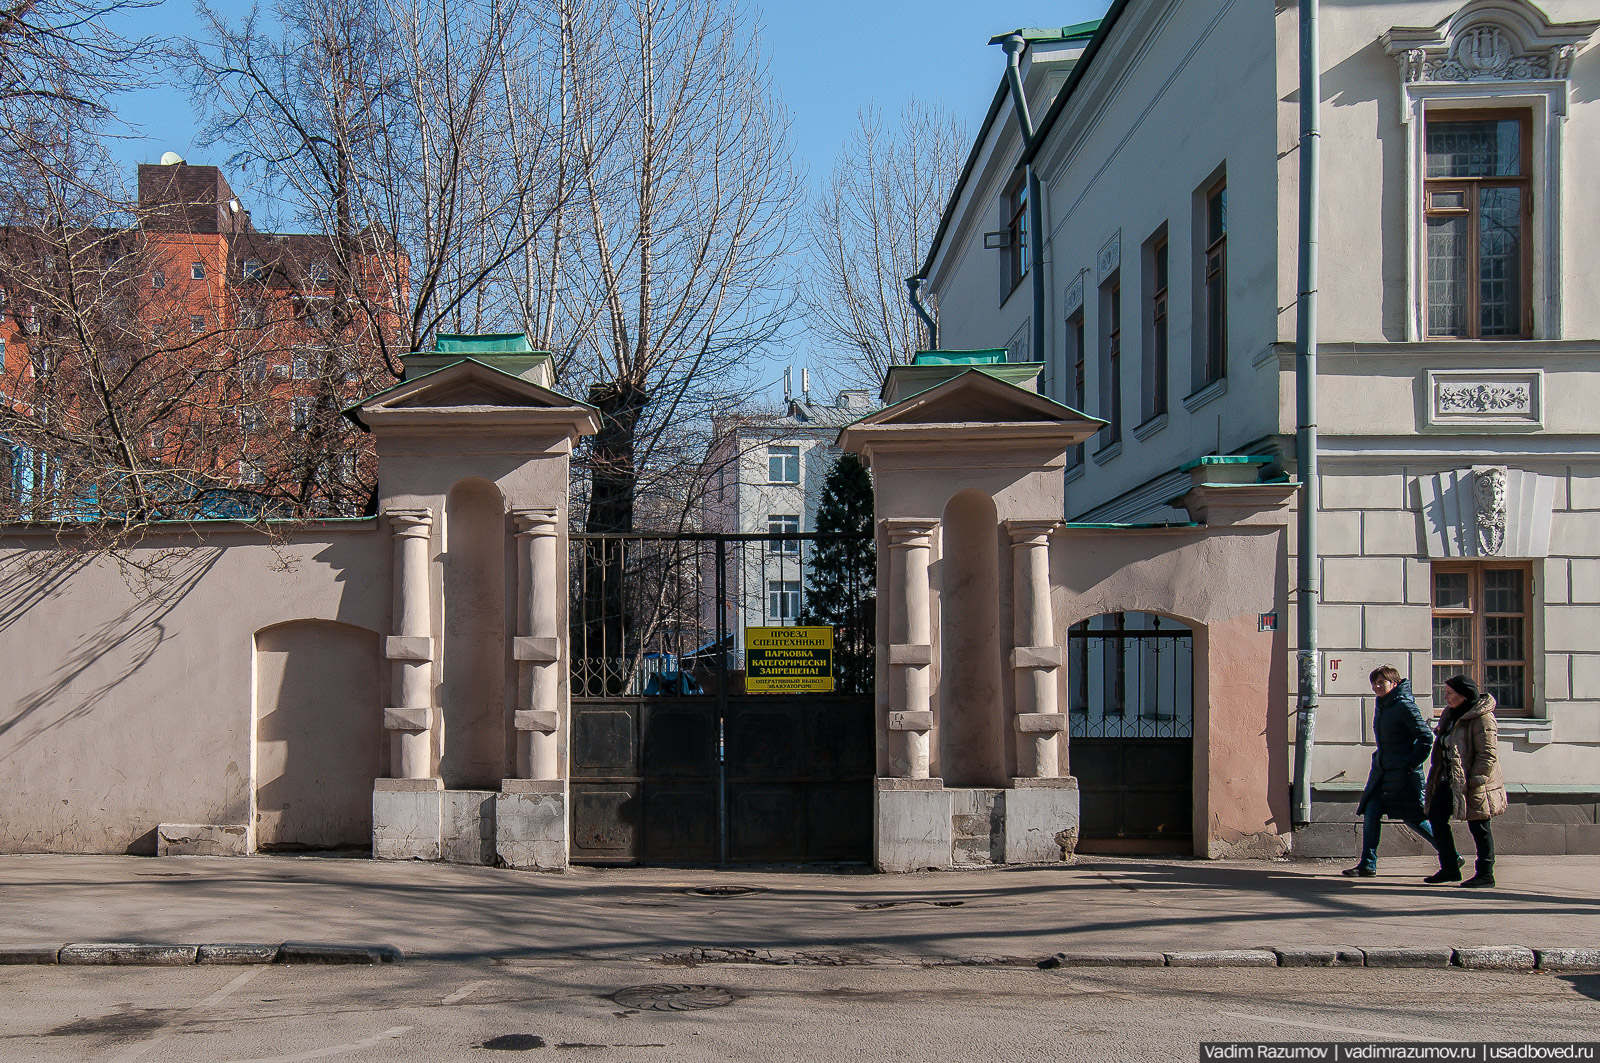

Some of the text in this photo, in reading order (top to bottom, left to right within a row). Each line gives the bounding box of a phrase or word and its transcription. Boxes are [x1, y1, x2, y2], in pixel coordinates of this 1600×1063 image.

[1330, 659, 1342, 670] ПГ
[760, 667, 818, 675] ЗАПРЕЩЕНА!
[1331, 673, 1338, 682] 9
